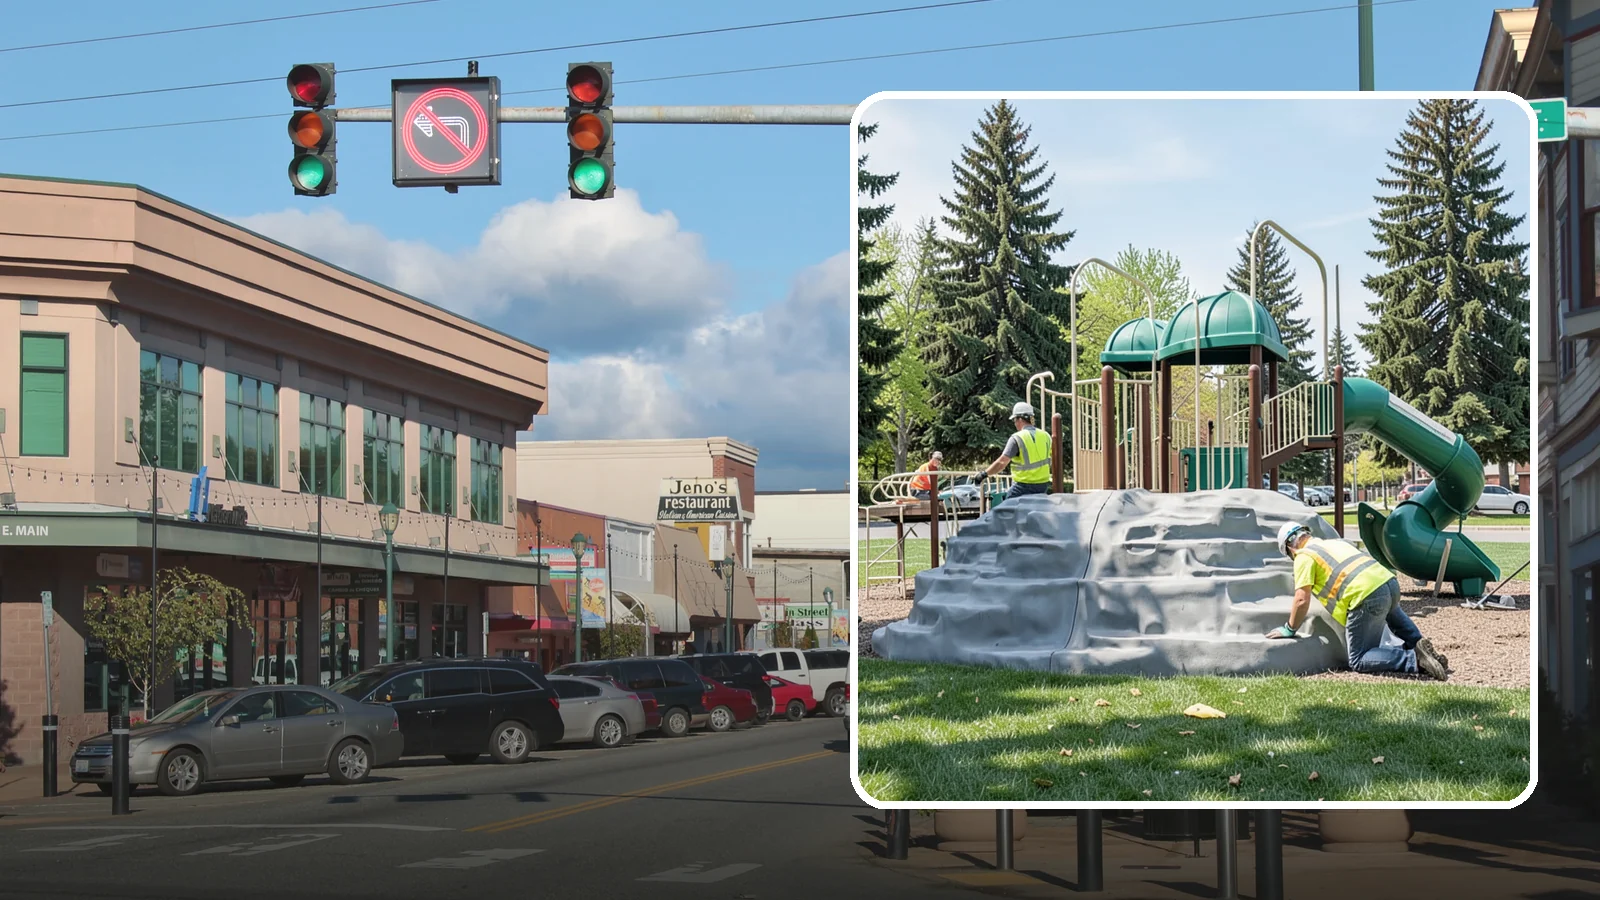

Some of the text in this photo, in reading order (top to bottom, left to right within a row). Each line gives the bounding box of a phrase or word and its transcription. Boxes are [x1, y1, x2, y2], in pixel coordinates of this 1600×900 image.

[670, 480, 728, 494] Jeno's
[665, 496, 730, 508] restaurant
[658, 510, 682, 520] Italian
[686, 510, 714, 520] American
[715, 510, 738, 520] Cuisine
[2, 526, 49, 536] E. MAIN
[798, 608, 828, 616] Street
